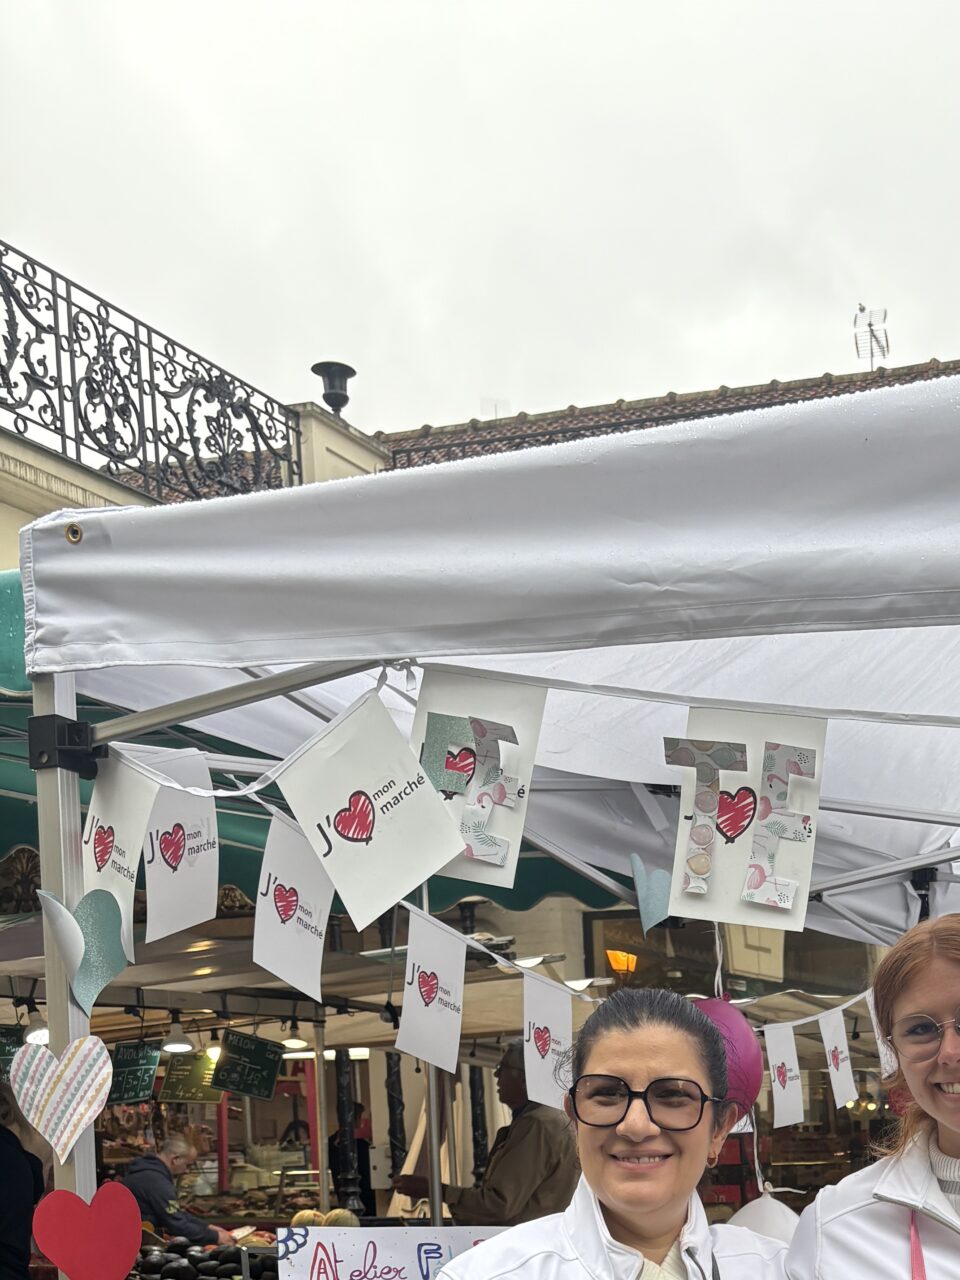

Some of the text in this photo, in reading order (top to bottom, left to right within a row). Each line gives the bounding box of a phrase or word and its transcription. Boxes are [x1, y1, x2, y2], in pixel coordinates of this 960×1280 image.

[380, 773, 425, 815] marché
[316, 780, 396, 857] J' mon
[186, 831, 202, 841] mon
[114, 845, 126, 858] mon
[188, 838, 216, 856] marché
[111, 860, 135, 883] marché
[298, 904, 312, 919] mon
[297, 916, 323, 939] marché
[438, 986, 451, 997] mon
[438, 997, 461, 1014] marché
